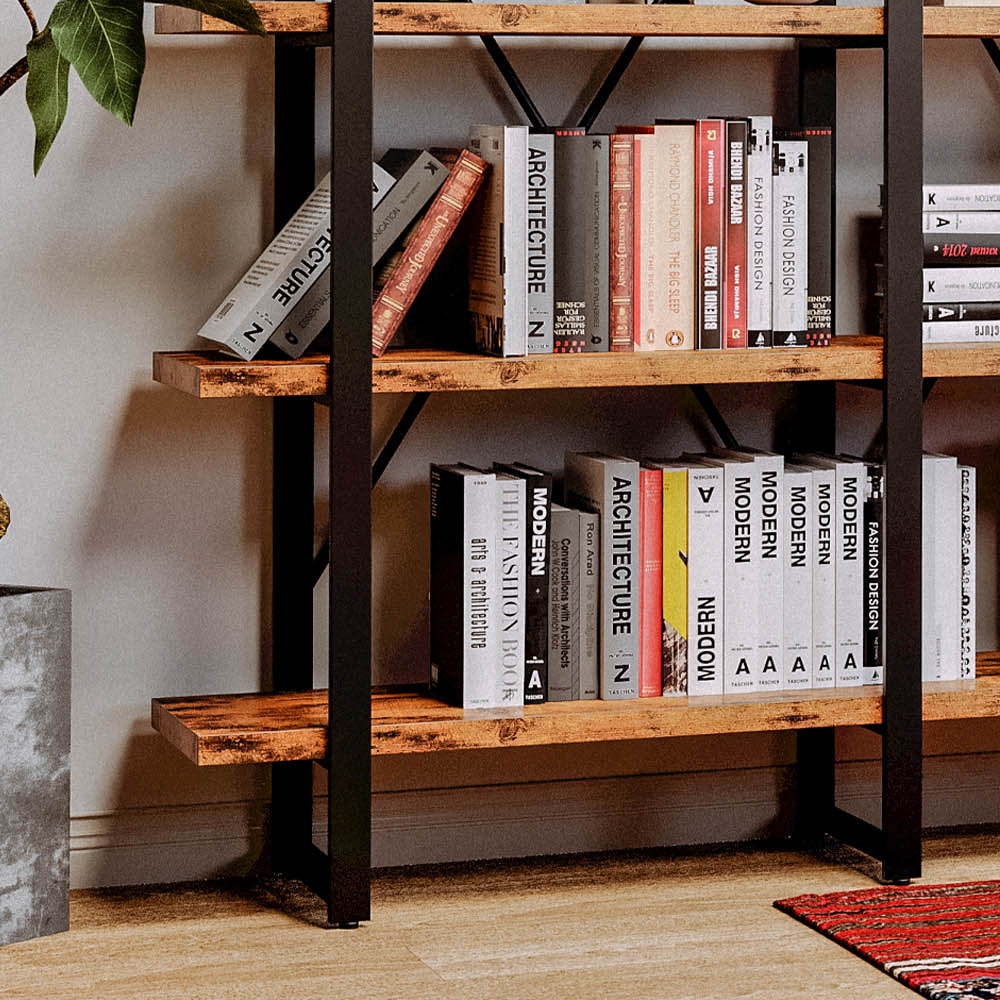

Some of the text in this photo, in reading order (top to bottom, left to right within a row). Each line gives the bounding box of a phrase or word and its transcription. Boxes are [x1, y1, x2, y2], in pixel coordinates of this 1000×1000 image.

[528, 148, 546, 294] ARCHITECTURE
[730, 141, 743, 224] BHENDI BAZAAR
[754, 177, 763, 290] FASHION DESIGN
[783, 195, 795, 296] FASHION DESIGN
[529, 321, 544, 338] Z
[704, 246, 718, 330] BHENDI BAZAAR
[532, 488, 548, 576] MODERN
[612, 477, 631, 635] ARCHITECTURE
[735, 477, 751, 563] MODERN
[762, 471, 777, 559] MODERN
[791, 487, 806, 567] MODERN
[818, 484, 830, 565] MODERN
[843, 477, 857, 560] MODERN
[502, 484, 519, 632] THE FASHION
[869, 521, 879, 631] FASHION DESIGN
[528, 670, 542, 689] A
[614, 664, 630, 683] Z
[697, 596, 715, 681] MODERN
[736, 658, 750, 675] A
[763, 656, 777, 672] A
